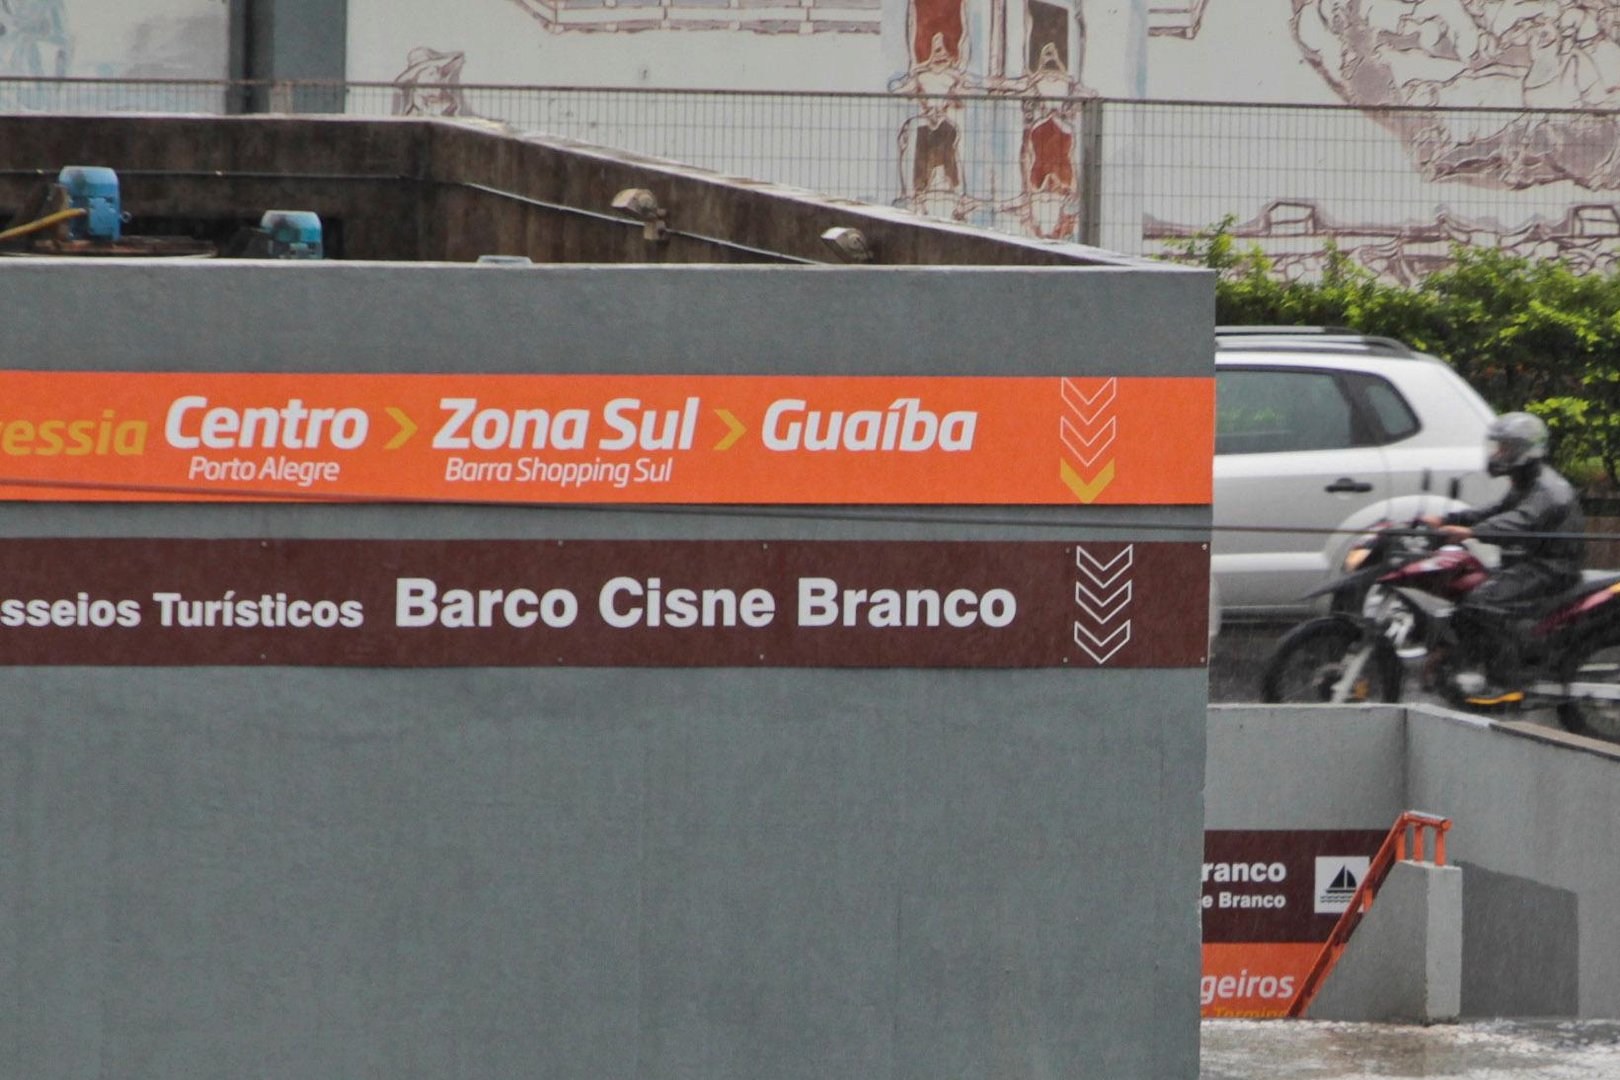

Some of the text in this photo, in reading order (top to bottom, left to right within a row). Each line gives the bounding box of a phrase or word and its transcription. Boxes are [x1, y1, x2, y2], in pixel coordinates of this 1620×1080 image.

[0, 395, 979, 456] essia Centro Zona Sul Guaíba
[187, 455, 342, 488] Porto Alegre
[443, 456, 674, 489] Barra Shopping Sul
[0, 576, 1018, 628] sseios Turísticos Barco Cisne Branco
[1217, 891, 1287, 909] Branco
[1200, 968, 1295, 1006] geiros
